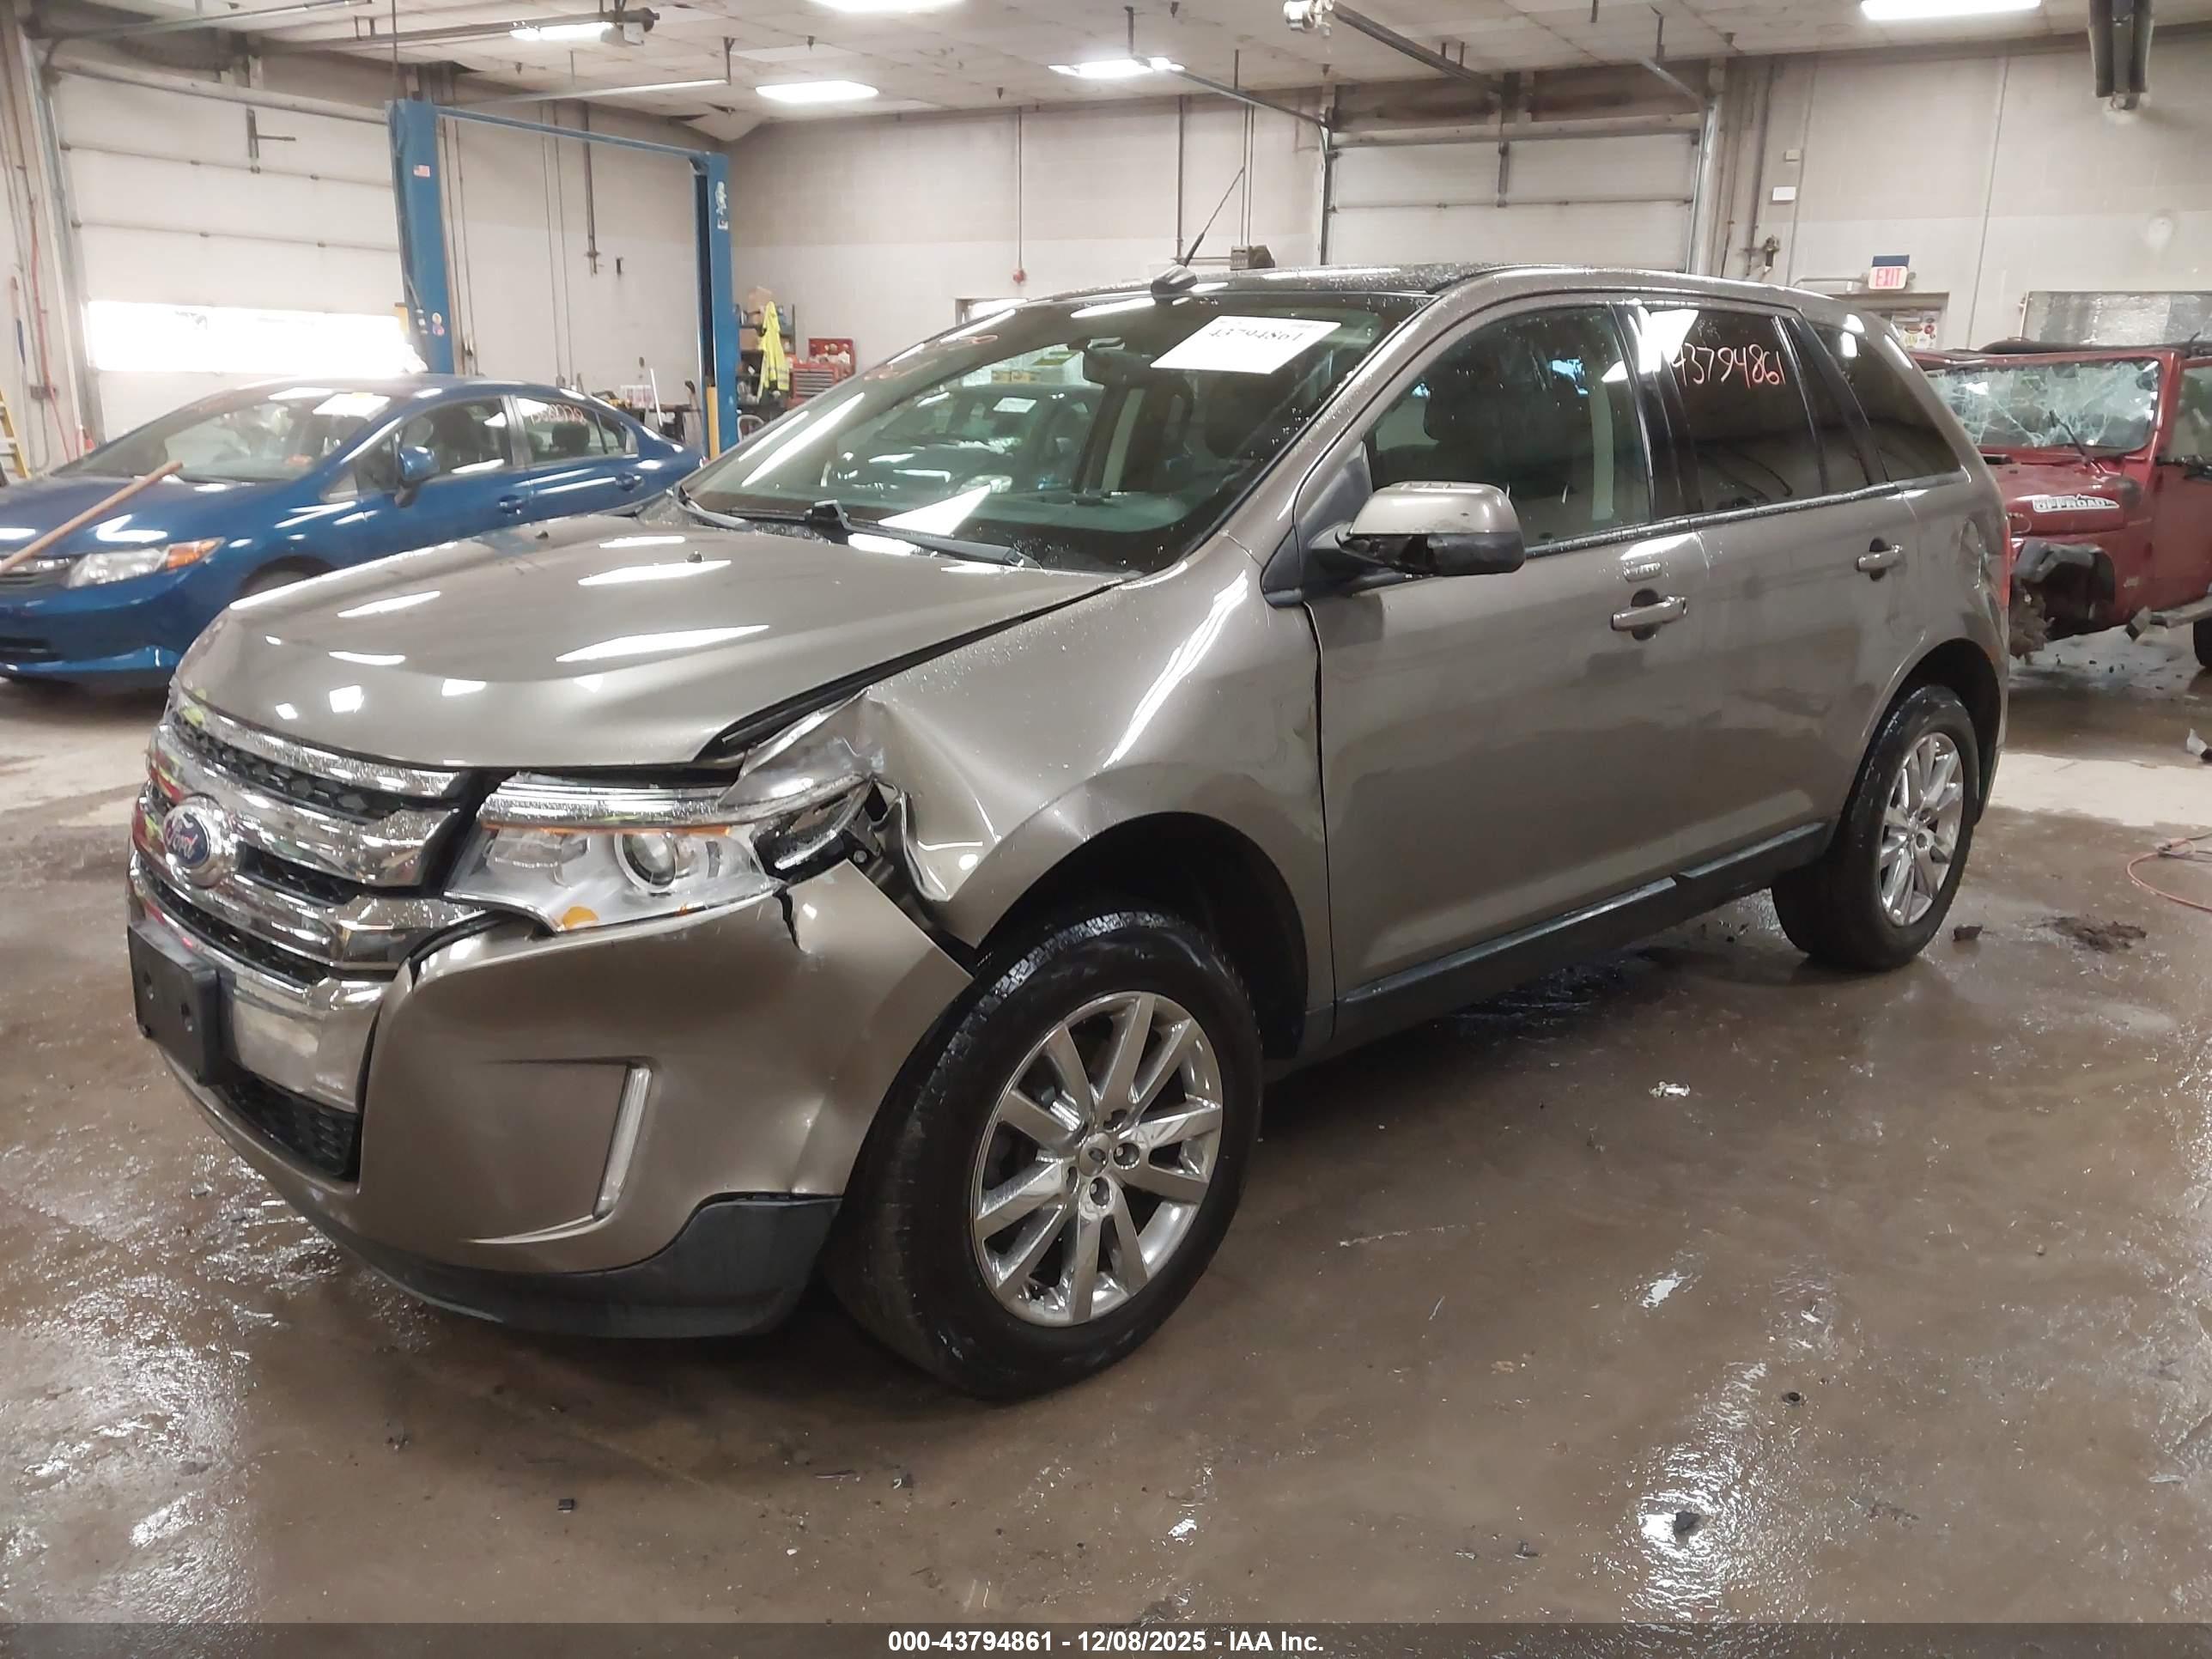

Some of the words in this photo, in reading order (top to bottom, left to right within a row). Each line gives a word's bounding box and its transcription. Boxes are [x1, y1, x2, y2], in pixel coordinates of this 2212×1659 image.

[1875, 267, 1903, 287] EXIT
[1670, 343, 1786, 389] 43794861
[167, 813, 199, 860] Ford
